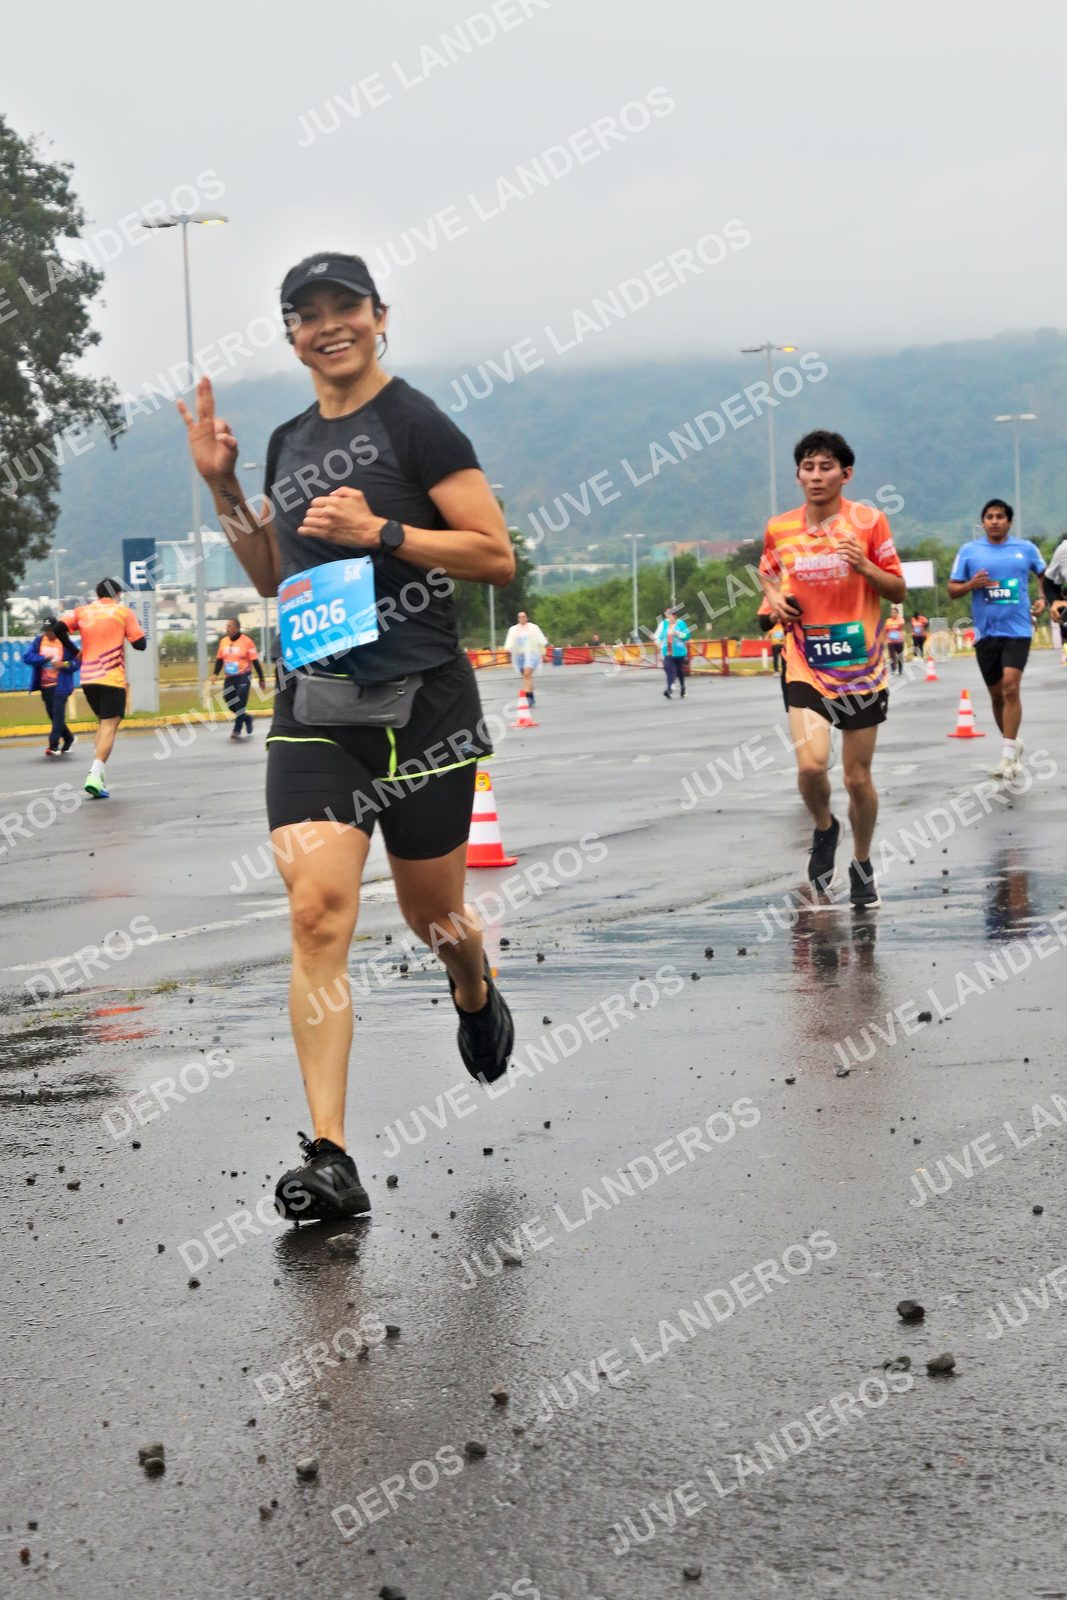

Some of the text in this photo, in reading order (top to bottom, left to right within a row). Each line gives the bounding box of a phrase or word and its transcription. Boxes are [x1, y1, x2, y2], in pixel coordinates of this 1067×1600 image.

[129, 561, 147, 584] E
[289, 598, 346, 641] 2026
[814, 641, 852, 656] 1164
